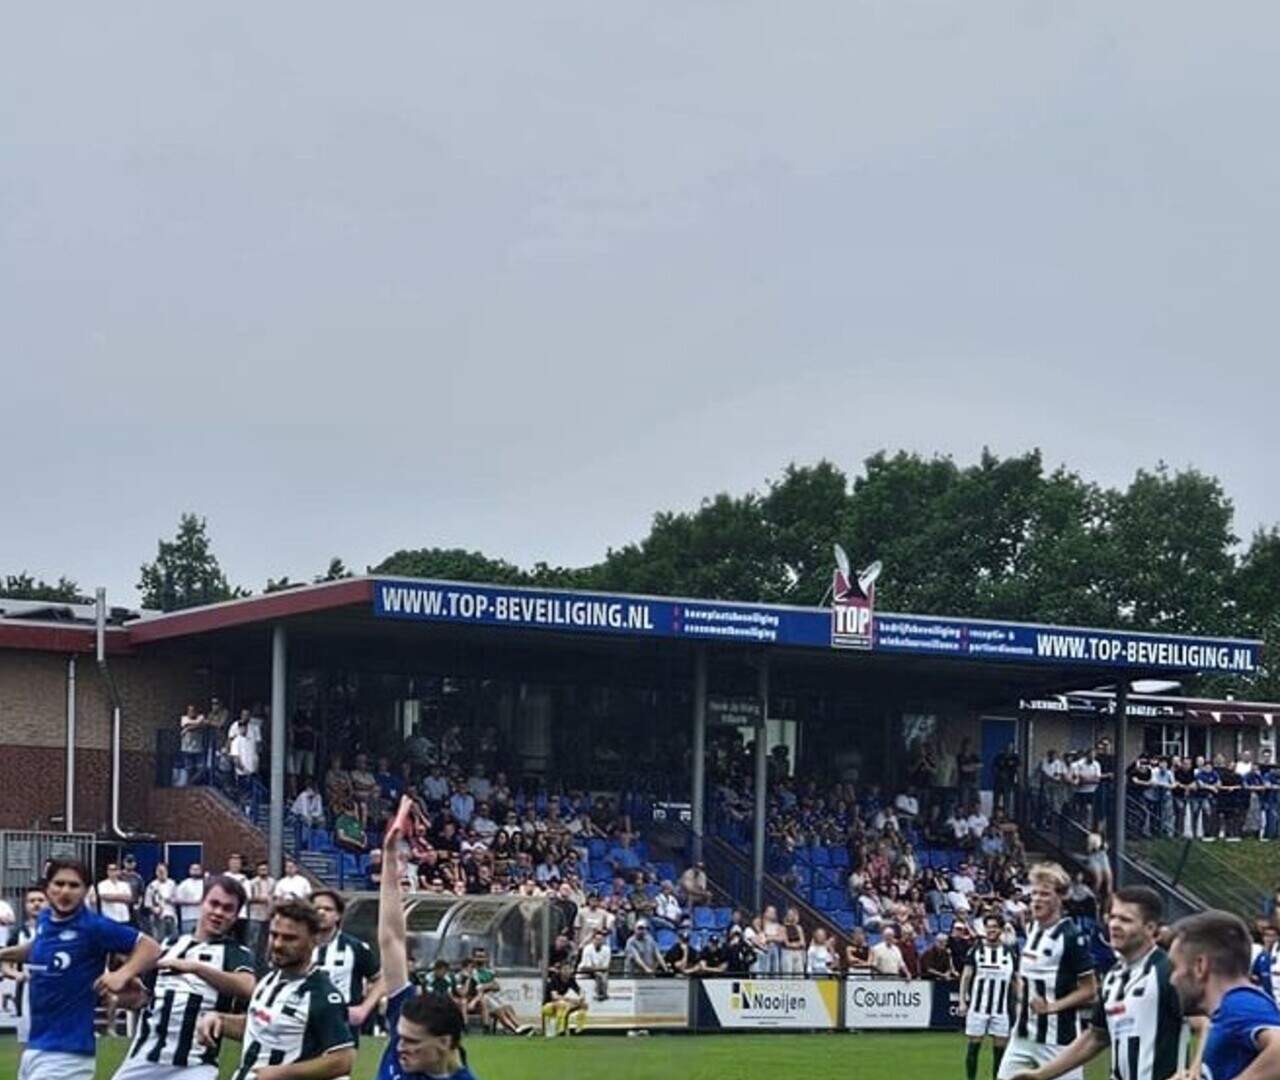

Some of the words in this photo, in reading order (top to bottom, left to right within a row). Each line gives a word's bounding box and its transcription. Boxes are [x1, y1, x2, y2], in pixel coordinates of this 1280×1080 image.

[381, 586, 654, 630] WWW.TOP-BEVEILIGING.NL
[835, 605, 871, 634] TOP
[1037, 633, 1255, 671] WWW.TOP-BEVEILIGING.NL
[853, 986, 922, 1008] Countus
